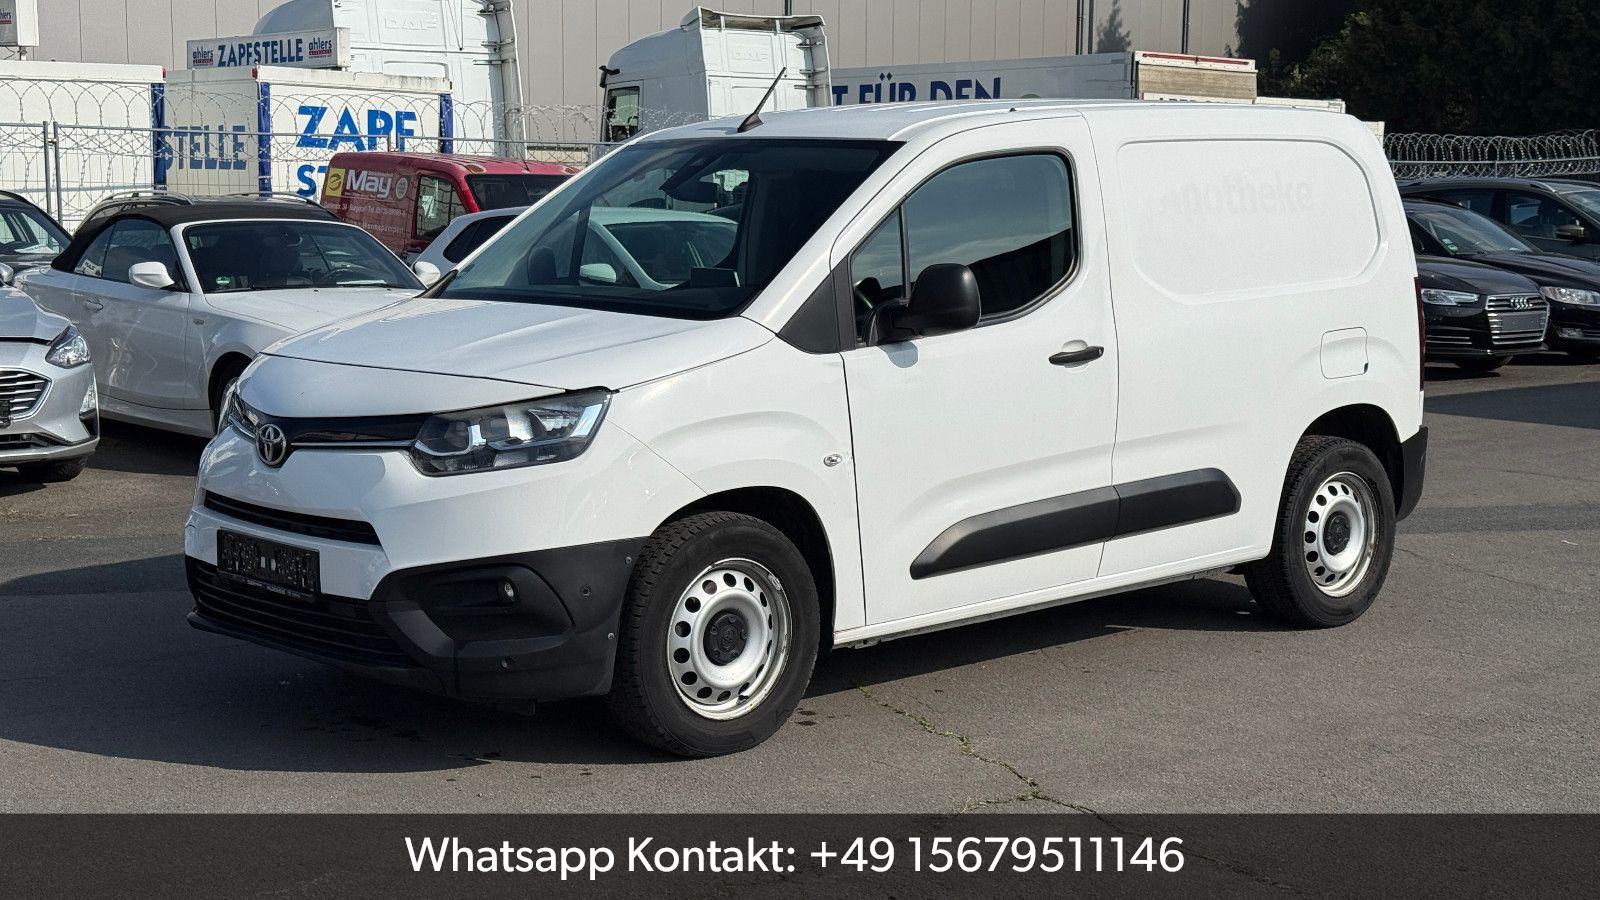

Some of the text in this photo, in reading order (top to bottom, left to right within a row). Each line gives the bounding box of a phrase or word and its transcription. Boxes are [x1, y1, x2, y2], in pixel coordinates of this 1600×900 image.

[192, 46, 214, 60] ahlers
[217, 38, 304, 67] ZAPFSTELLE
[308, 37, 333, 51] ahlers
[859, 72, 917, 104] FÜR
[930, 76, 1001, 100] DEN
[295, 105, 417, 152] ZAPF
[345, 169, 393, 199] May
